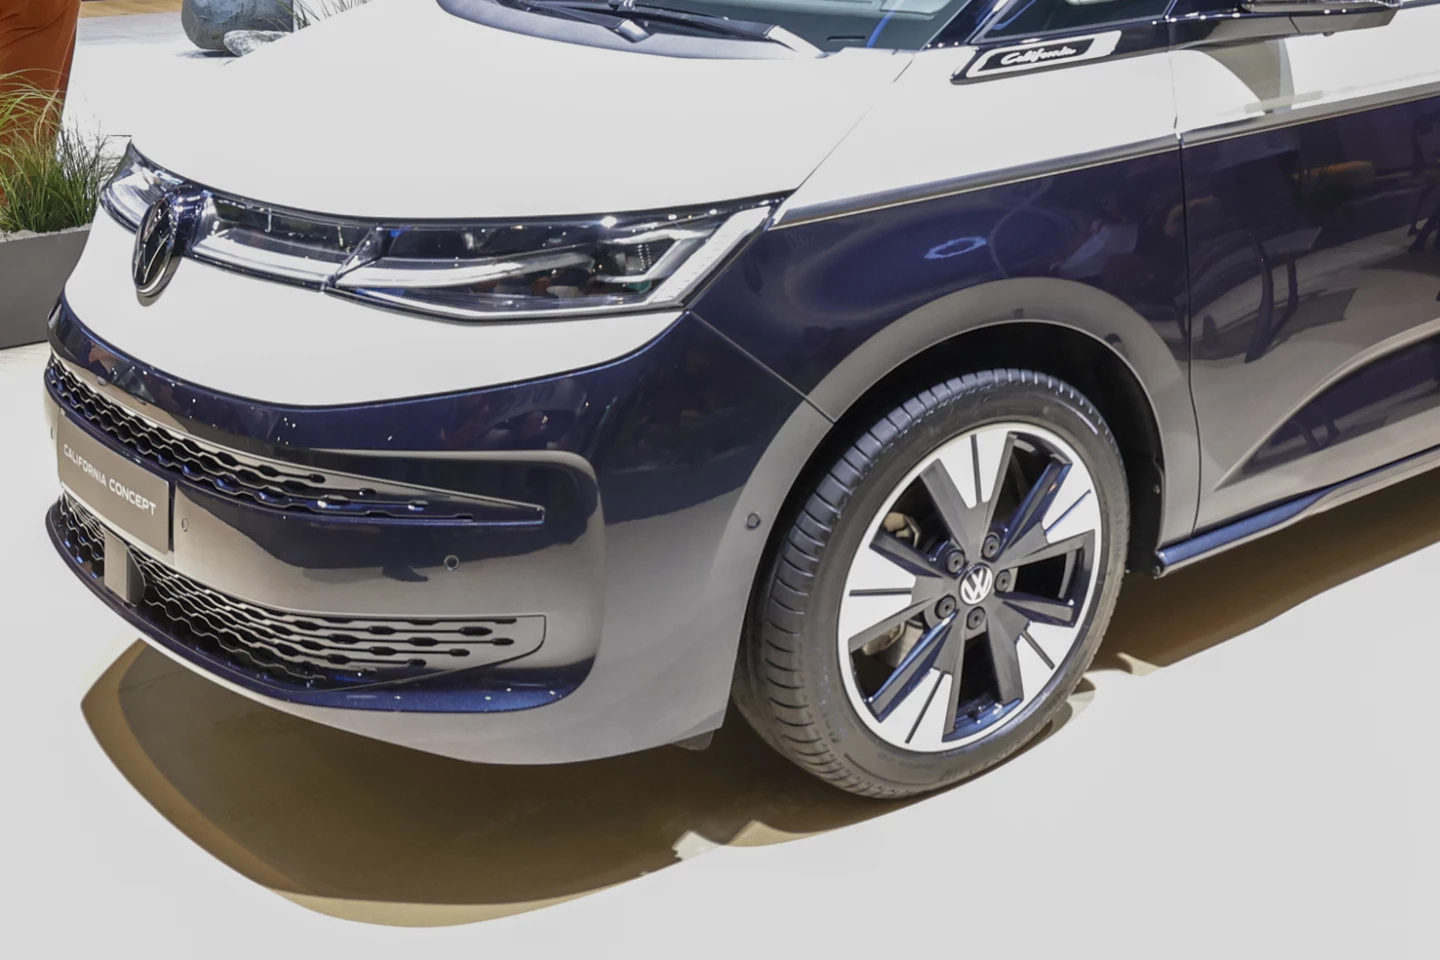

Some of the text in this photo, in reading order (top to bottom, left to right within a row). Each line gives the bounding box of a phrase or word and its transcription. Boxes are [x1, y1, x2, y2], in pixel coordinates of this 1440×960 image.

[1000, 45, 1077, 66] California
[63, 443, 157, 516] CALIFORNIA CONCEPT
